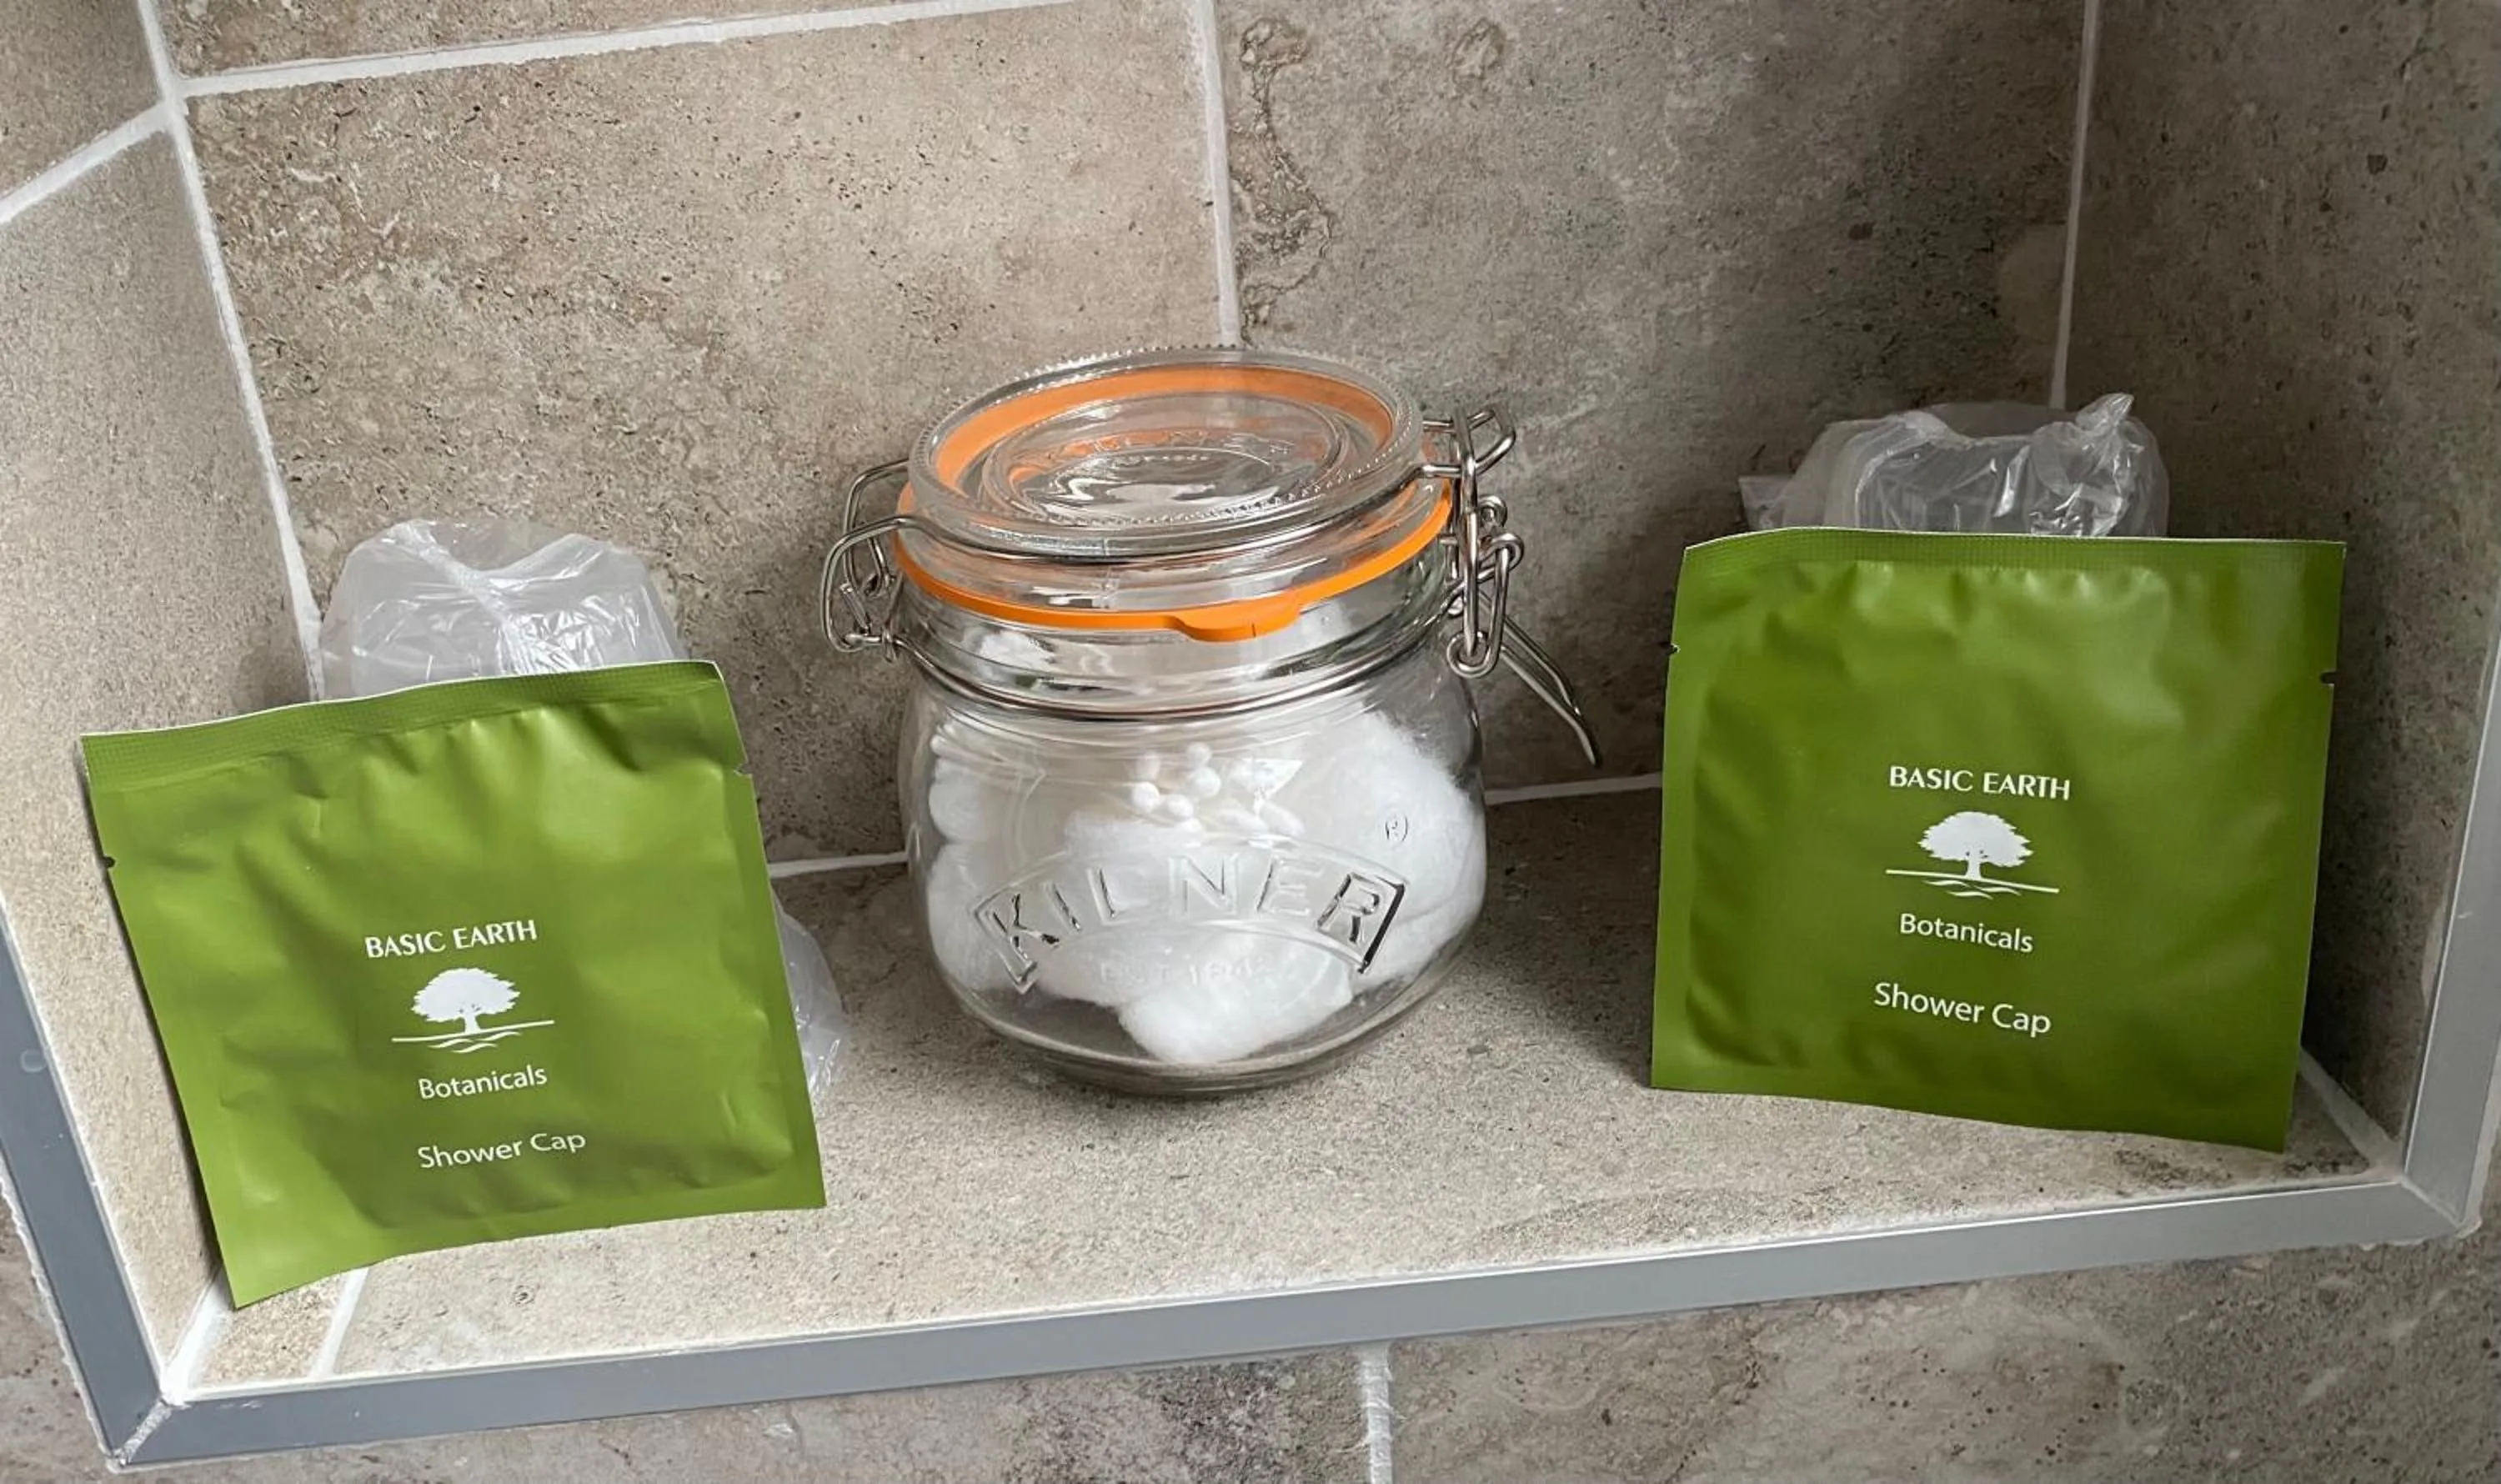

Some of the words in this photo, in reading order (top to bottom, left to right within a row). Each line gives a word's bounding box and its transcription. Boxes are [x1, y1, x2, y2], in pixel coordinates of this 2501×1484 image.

[1889, 765, 1974, 792] BASIC
[1982, 772, 2070, 800] EARTH
[989, 854, 1382, 962] KILNER
[364, 930, 447, 958] BASIC
[453, 919, 538, 950] EARTH
[1899, 913, 2033, 953] Botanicals
[1874, 982, 1985, 1023] Shower
[1991, 1003, 2052, 1038] Cap
[419, 1064, 548, 1100] Botanicals
[418, 1140, 523, 1168] Shower
[529, 1132, 586, 1154] Cap
